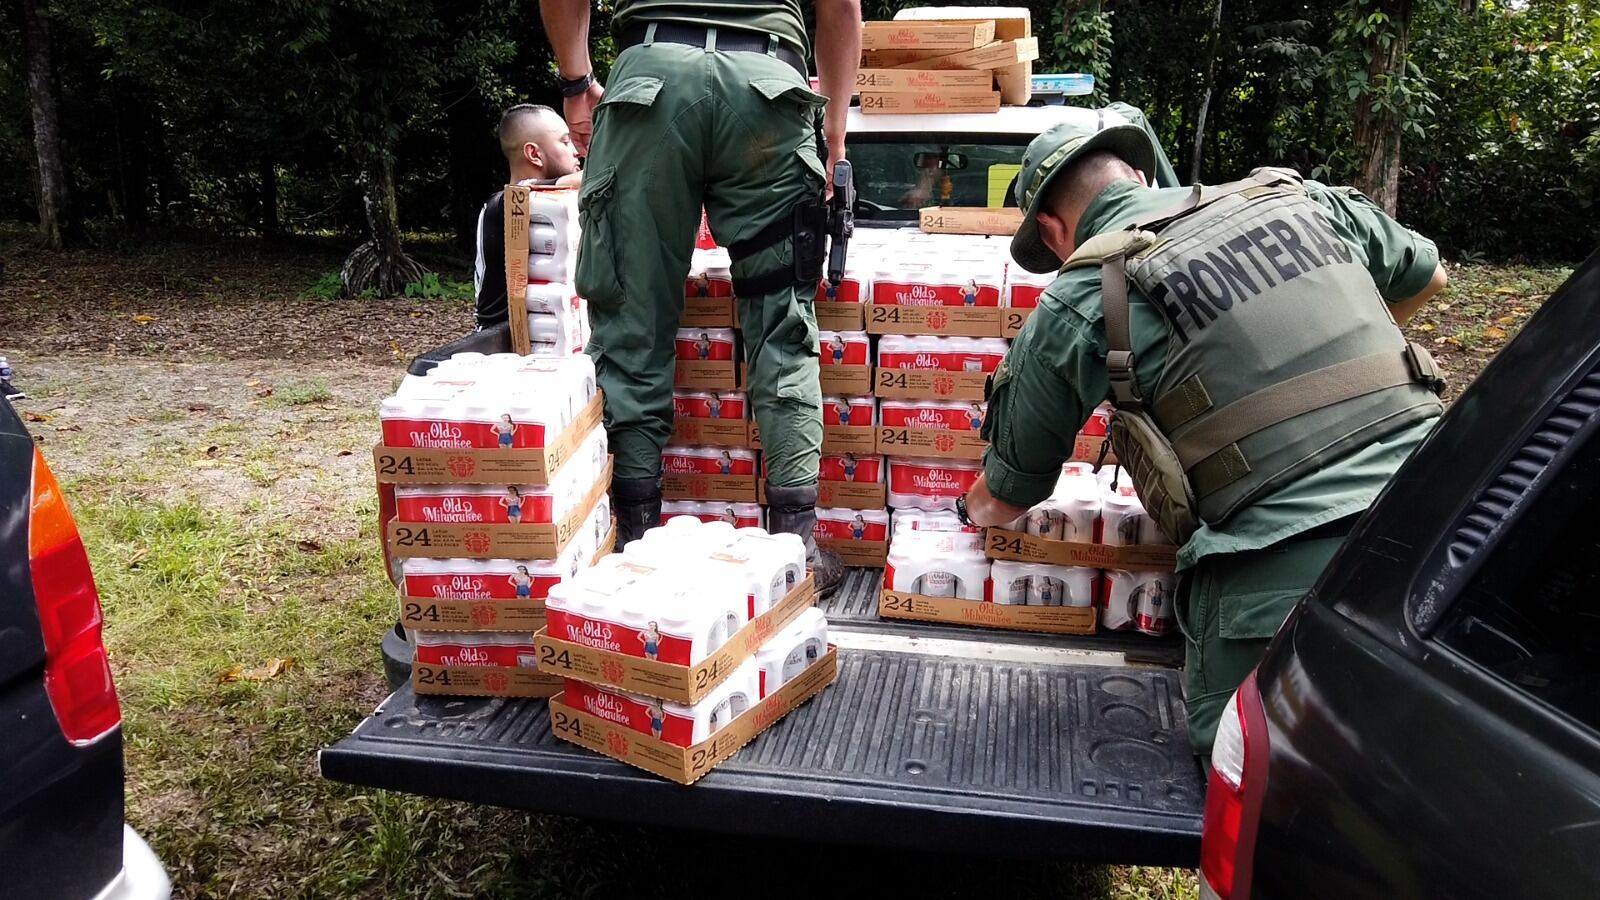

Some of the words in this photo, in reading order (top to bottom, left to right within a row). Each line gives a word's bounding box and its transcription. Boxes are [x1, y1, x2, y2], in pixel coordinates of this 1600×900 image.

[856, 73, 876, 86] 24
[864, 96, 884, 109] 24
[511, 190, 525, 217] 24
[923, 215, 944, 228] 24
[1149, 210, 1353, 345] FRONTERAS
[896, 290, 944, 306] Milwaukee
[912, 286, 934, 299] Old
[872, 307, 900, 323] 24
[1007, 313, 1024, 330] 2
[916, 354, 938, 367] Old
[880, 371, 907, 389] 24
[904, 415, 950, 429] Milwaukee
[920, 409, 941, 422] Old
[410, 429, 472, 449] Milwaukee
[430, 422, 459, 440] Old
[881, 428, 909, 445] 24
[379, 455, 415, 475] 24
[548, 448, 560, 473] 24
[913, 475, 960, 489] Milwaukee
[929, 469, 951, 482] Old
[423, 503, 483, 523] Milwaukee
[443, 497, 470, 513] Old
[396, 527, 432, 547] 24
[559, 518, 572, 543] 24
[991, 535, 1022, 555] 24
[432, 583, 492, 601] Milwaukee
[452, 576, 479, 591] Old
[405, 603, 440, 622] 24
[884, 595, 914, 613] 24
[978, 602, 1003, 615] Old
[566, 624, 621, 652] Milwaukee
[583, 620, 609, 639] Old
[460, 647, 485, 662] Old
[540, 645, 573, 670] 24
[418, 667, 452, 686] 24
[696, 660, 719, 692] 24
[583, 695, 630, 726] Milwaukee
[597, 692, 621, 712] Old
[554, 711, 583, 738] 24
[692, 739, 718, 773] 24
